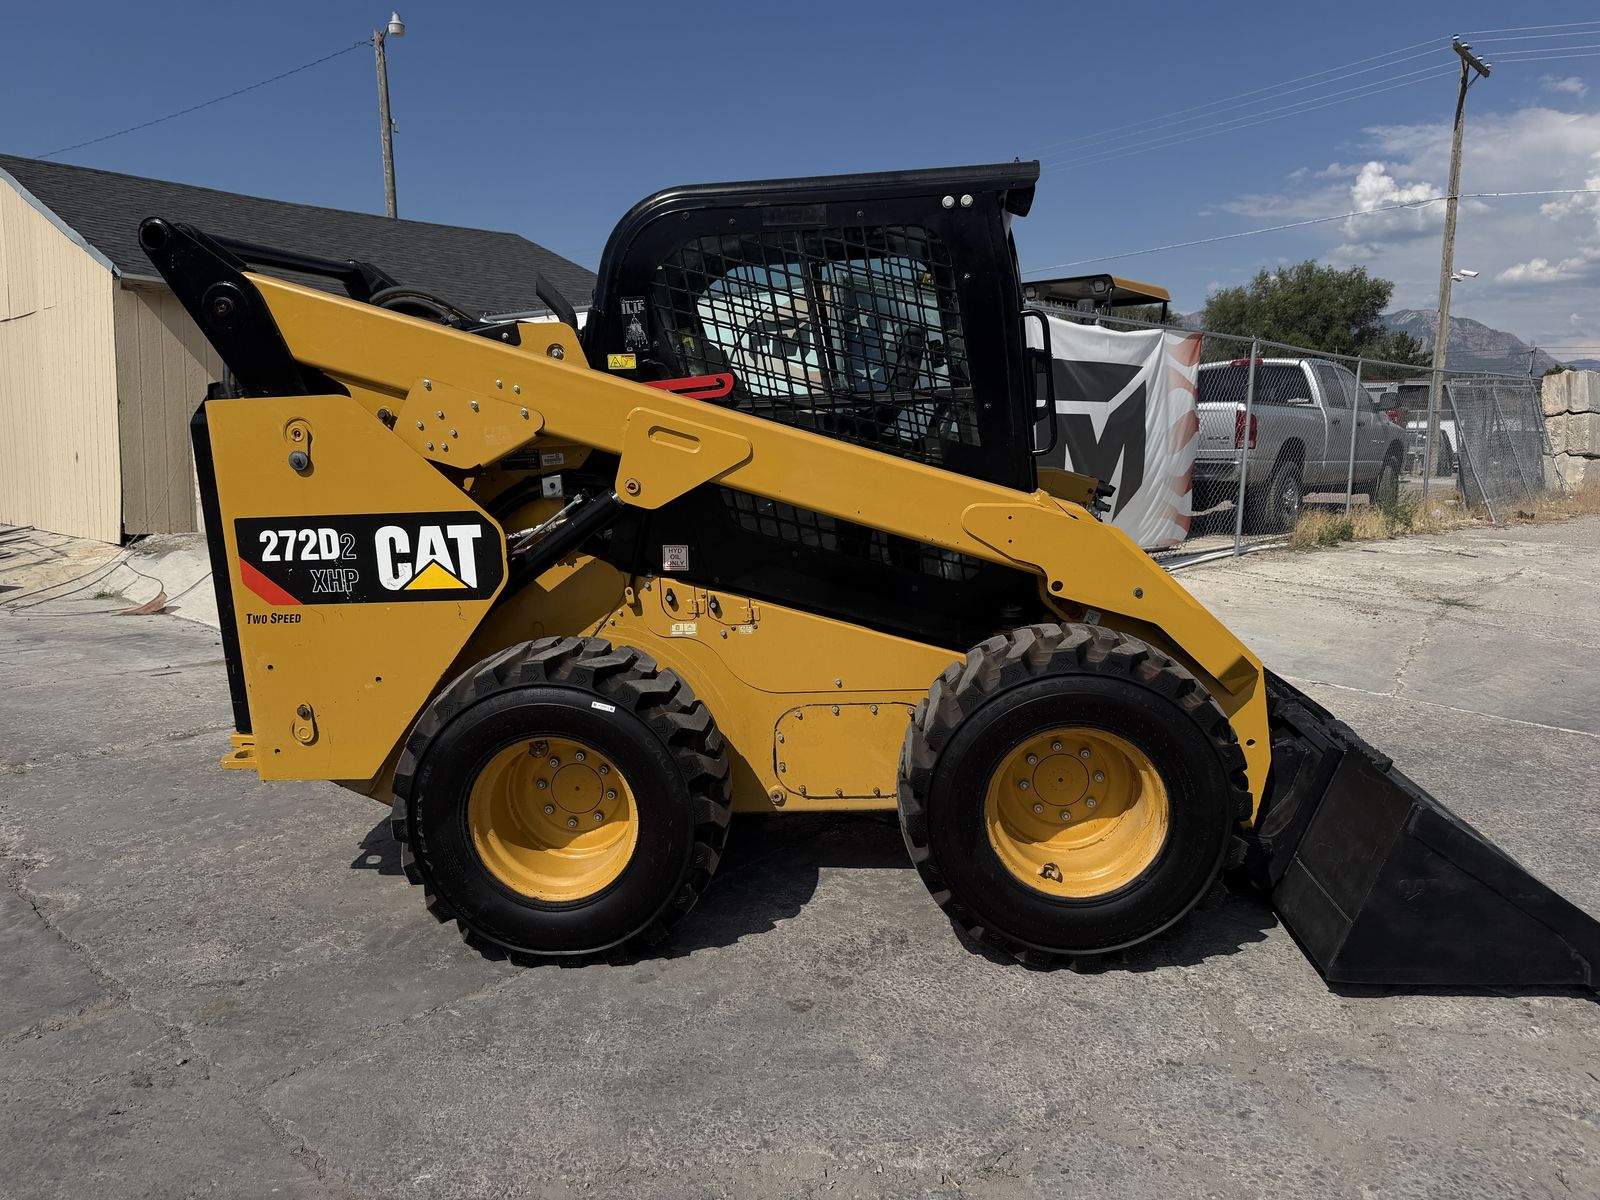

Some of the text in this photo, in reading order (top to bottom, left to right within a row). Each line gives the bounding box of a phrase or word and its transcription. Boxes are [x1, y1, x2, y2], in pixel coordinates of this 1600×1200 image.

[259, 528, 357, 562] 272D2
[374, 524, 482, 591] CAT
[310, 569, 359, 593] XHP
